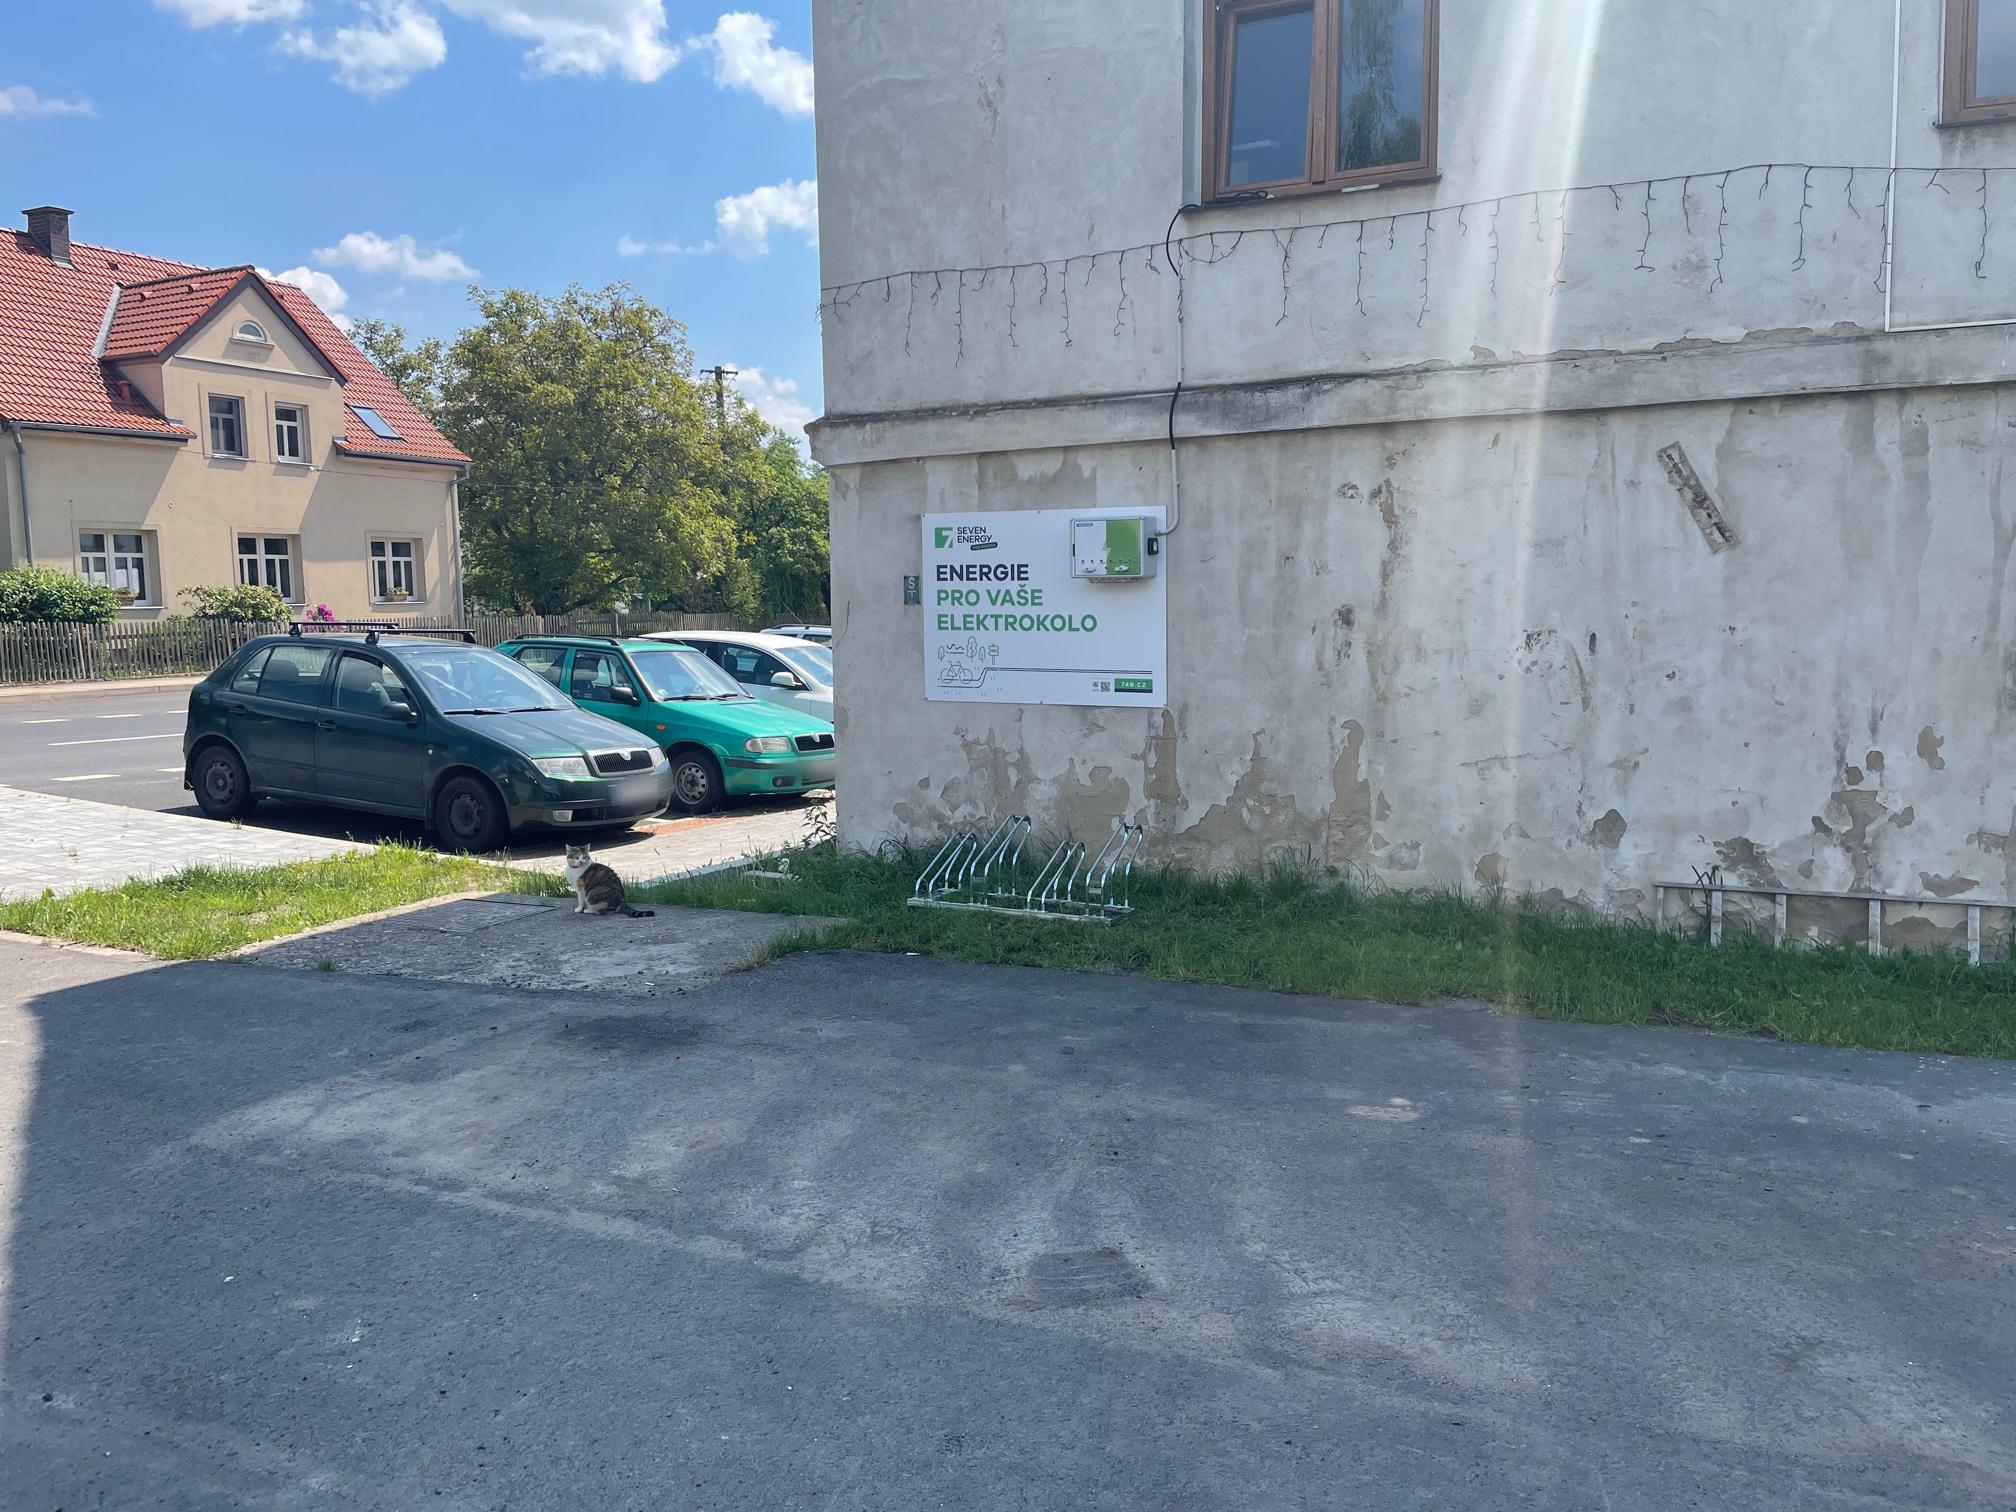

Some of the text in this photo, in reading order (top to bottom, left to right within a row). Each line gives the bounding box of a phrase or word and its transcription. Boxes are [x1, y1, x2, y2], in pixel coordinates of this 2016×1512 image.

[957, 526, 987, 535] SEVEN
[957, 534, 993, 544] ENERGY
[936, 564, 1029, 582] ENERGIE
[936, 584, 1044, 607] PRO VAŠE
[936, 614, 1098, 632] ELEKTROKOLO
